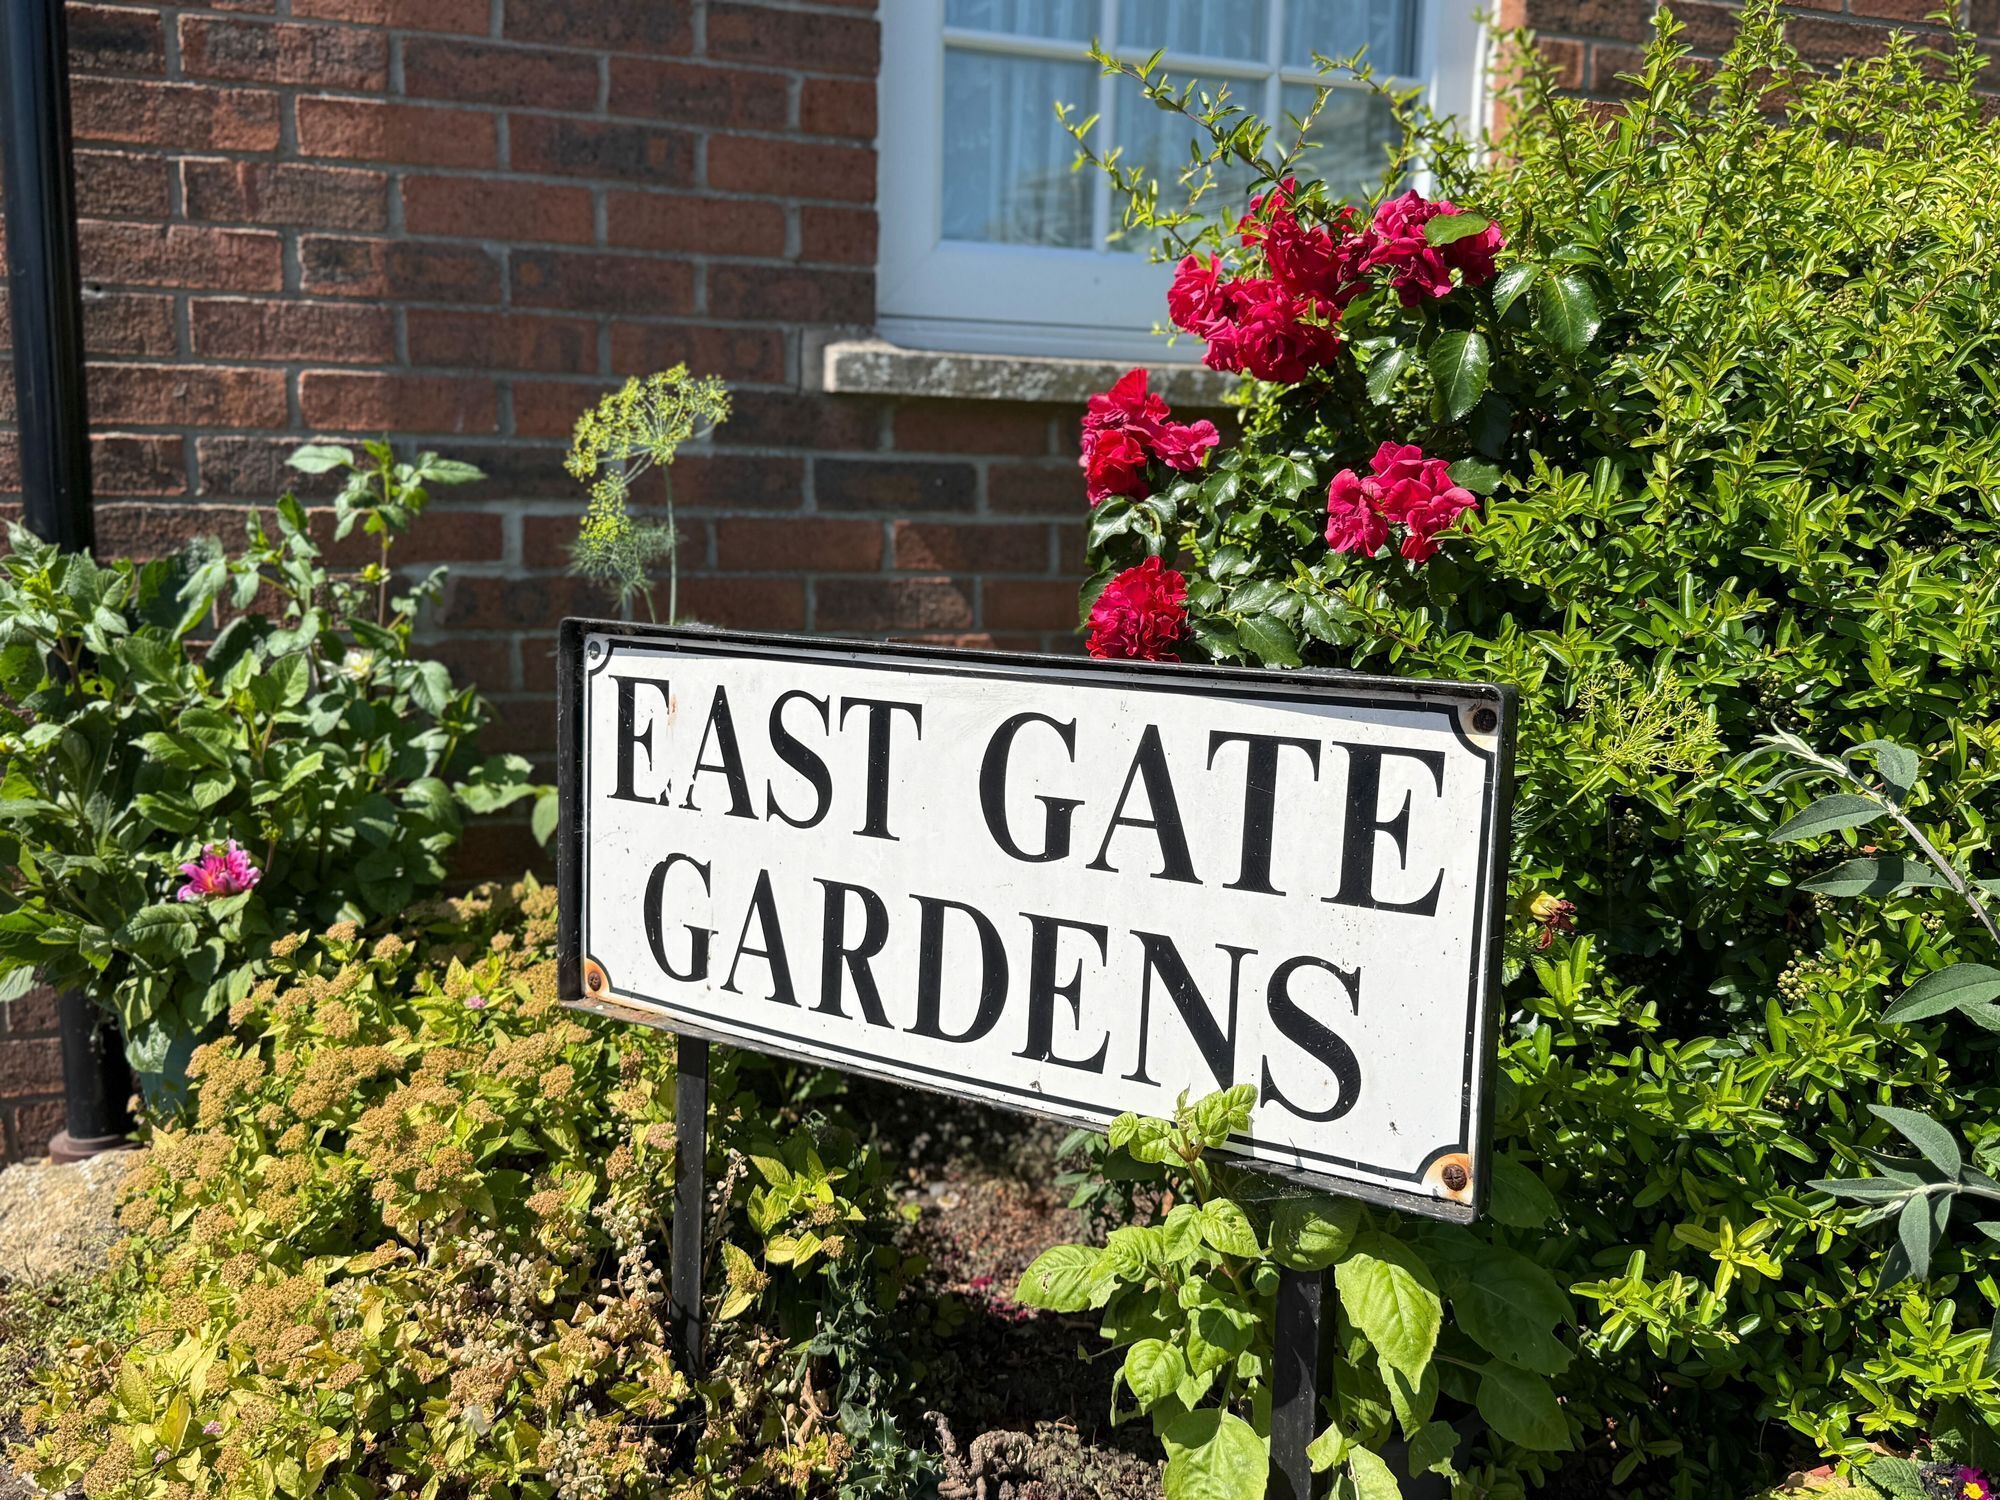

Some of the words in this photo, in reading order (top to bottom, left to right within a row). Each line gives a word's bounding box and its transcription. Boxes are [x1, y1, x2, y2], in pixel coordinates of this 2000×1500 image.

[607, 675, 922, 841] EAST
[980, 712, 1445, 916] GATE
[644, 853, 1361, 1122] GARDENS
